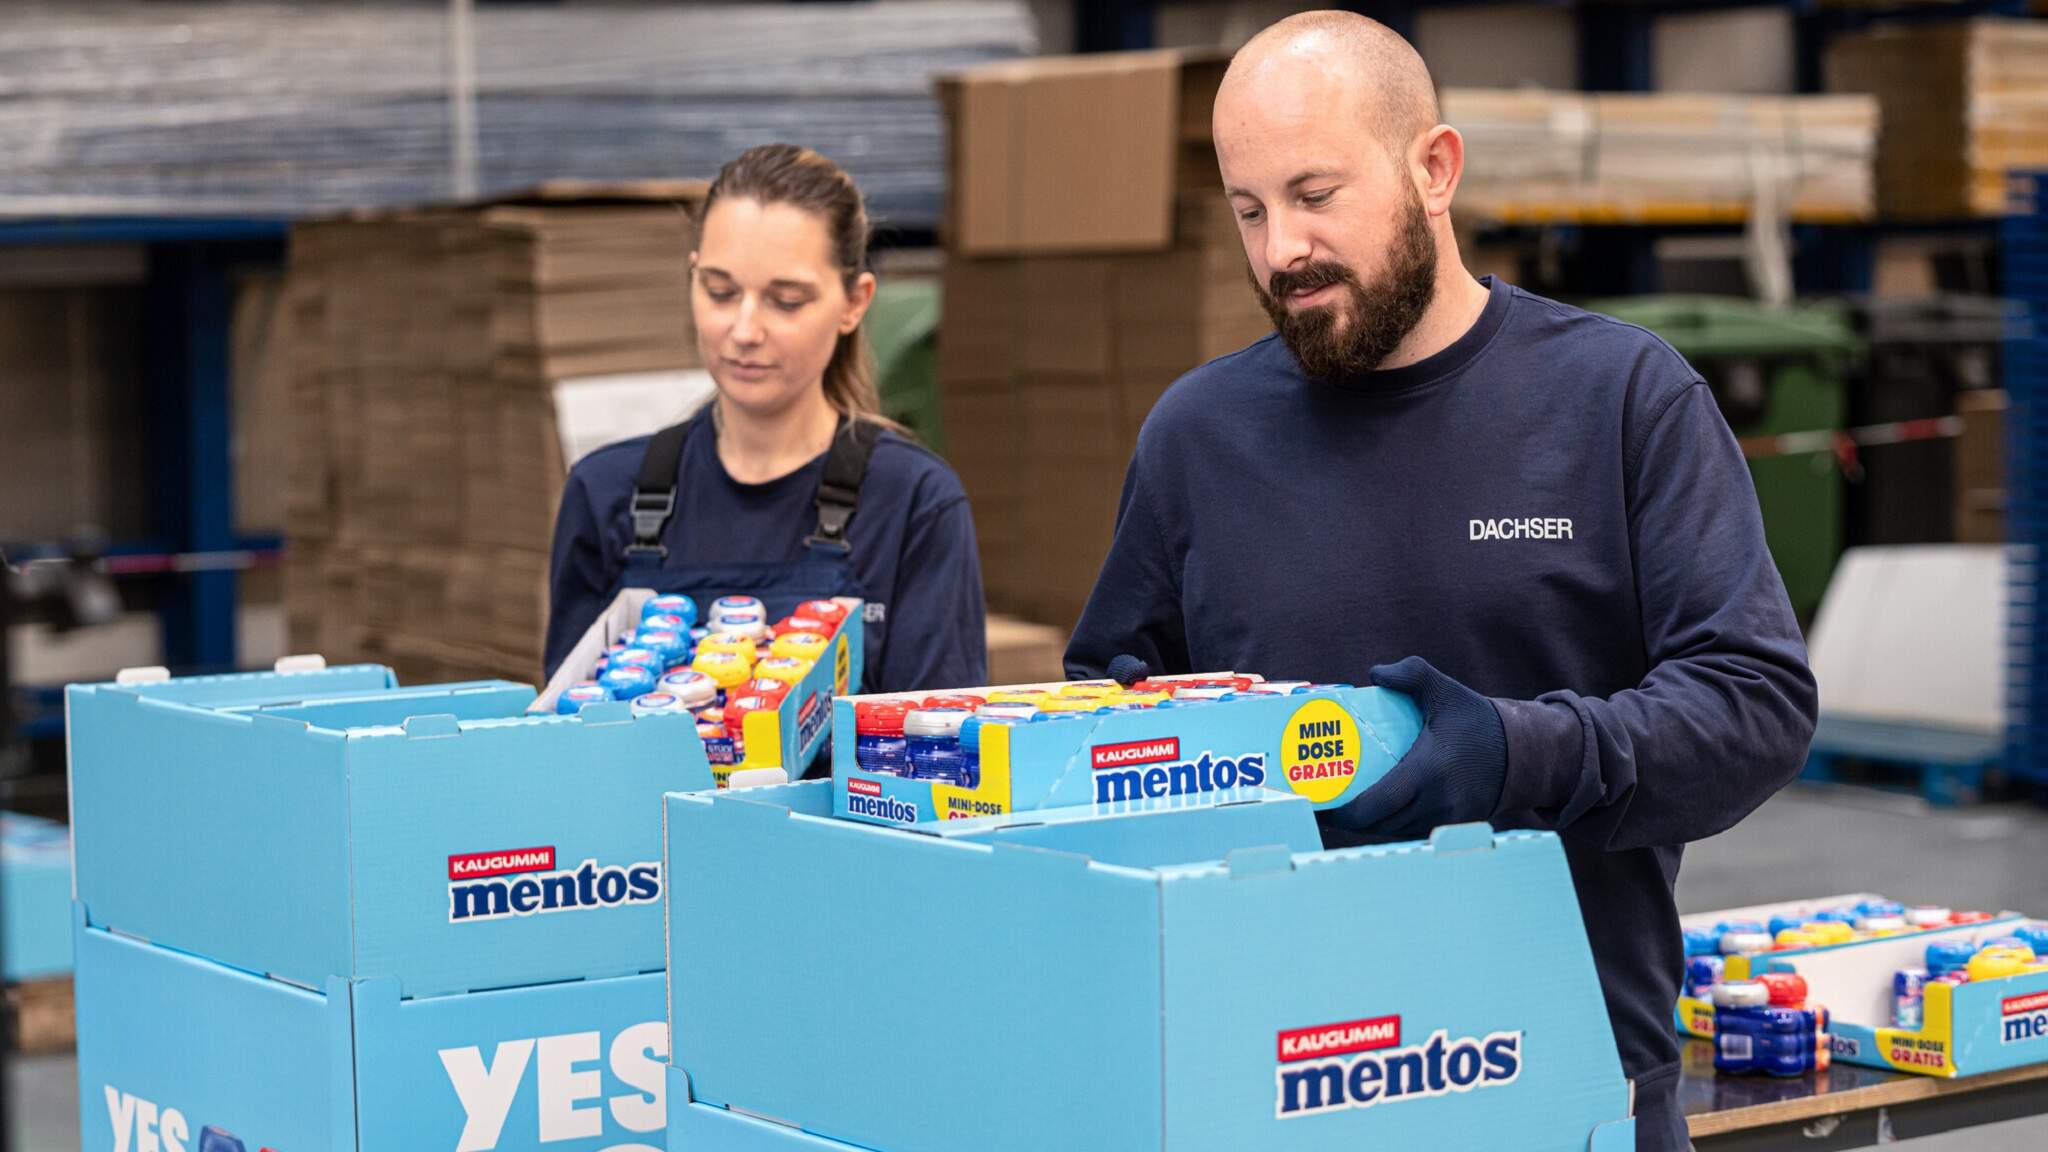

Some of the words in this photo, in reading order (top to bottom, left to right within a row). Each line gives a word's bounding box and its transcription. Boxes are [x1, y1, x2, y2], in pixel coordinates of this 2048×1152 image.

[1469, 517, 1573, 540] DACHSER
[1299, 720, 1341, 739] MINI
[1095, 743, 1175, 764] KAUGUMMI
[1298, 740, 1344, 761] DOSE
[1096, 753, 1265, 803] mentos
[1288, 759, 1355, 782] GRATIS
[848, 794, 916, 824] mentos
[453, 851, 550, 874] KAUGUMMI
[452, 863, 660, 919] mentos
[1281, 1021, 1395, 1056] KAUGUMMI
[1890, 1047, 1944, 1067] GRATIS
[437, 1021, 669, 1152] YES
[1280, 1034, 1519, 1113] mentos
[104, 1084, 189, 1152] YES
